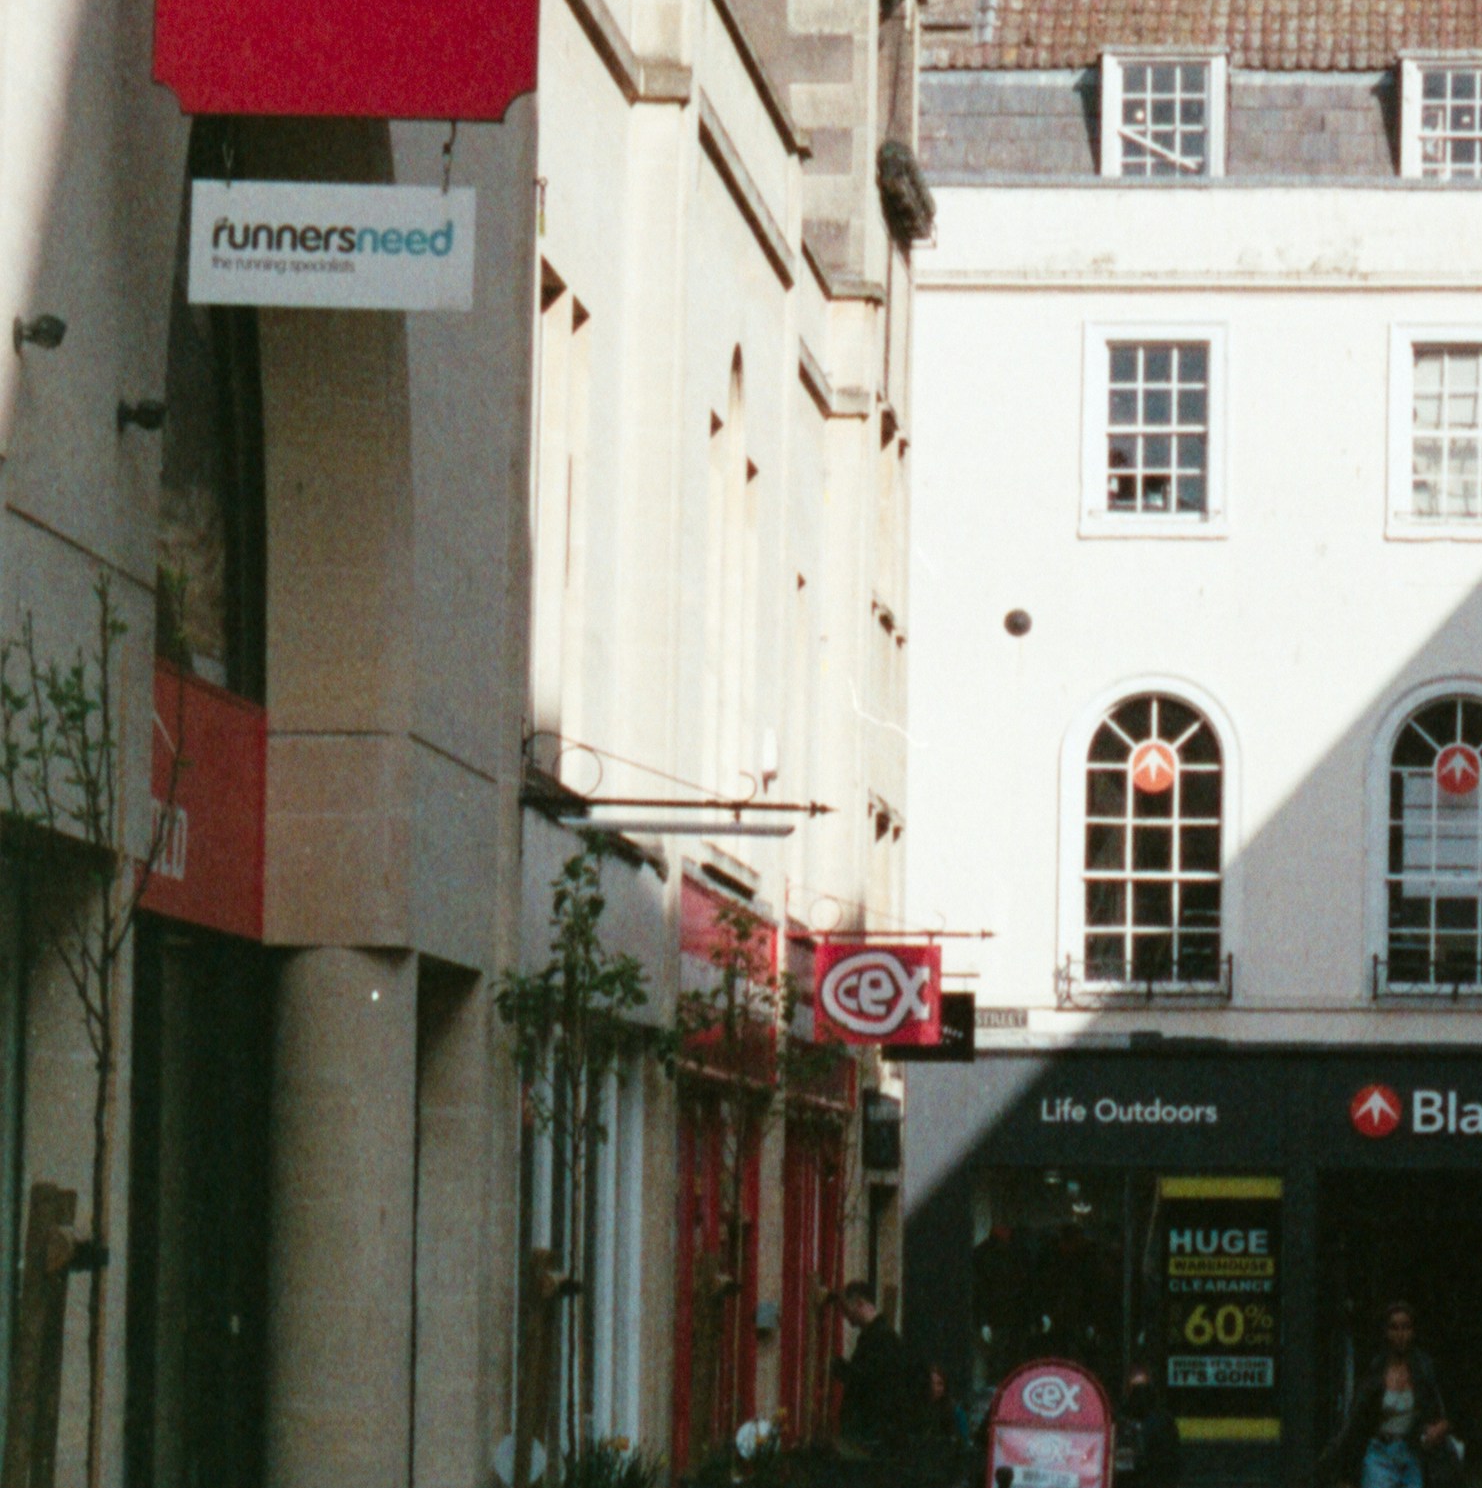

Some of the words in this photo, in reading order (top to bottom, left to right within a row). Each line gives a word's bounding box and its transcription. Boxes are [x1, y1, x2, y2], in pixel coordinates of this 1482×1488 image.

[211, 217, 454, 257] runnersneed
[1040, 1097, 1087, 1123] Life
[1094, 1097, 1218, 1123] Outdoors
[1168, 1228, 1269, 1255] HUGE
[1168, 1279, 1273, 1293] CLEARANCE
[1215, 1370, 1267, 1383] GONE
